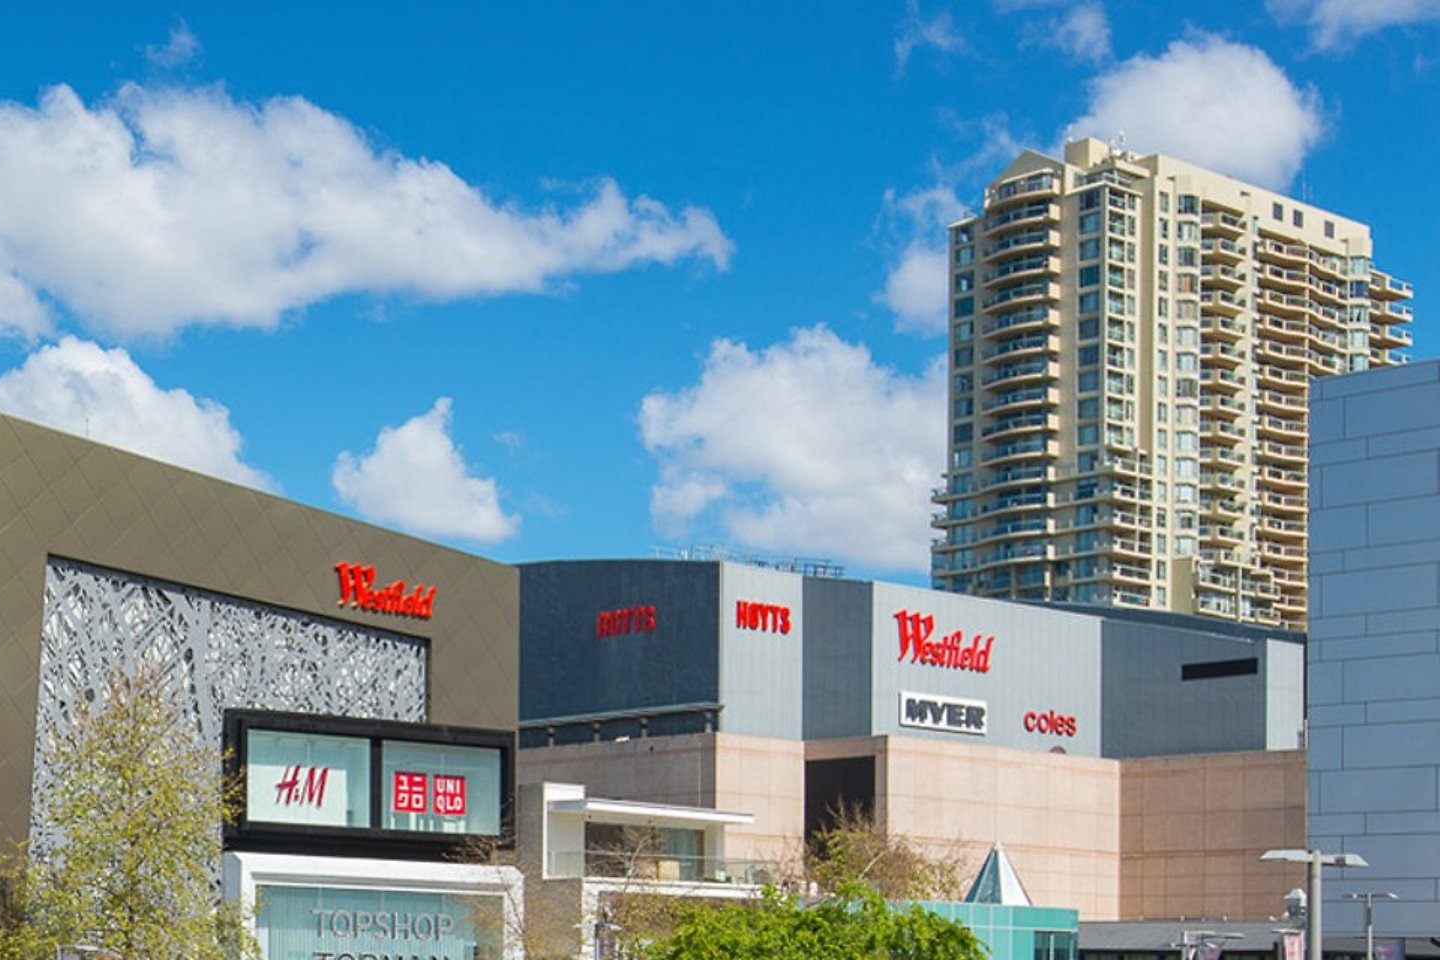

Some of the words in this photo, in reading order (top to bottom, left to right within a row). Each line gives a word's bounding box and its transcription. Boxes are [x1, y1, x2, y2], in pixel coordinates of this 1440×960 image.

[335, 561, 437, 619] Westfield
[736, 600, 791, 635] HOYTS
[893, 609, 994, 674] Westfield
[905, 698, 986, 730] MYER
[1024, 709, 1076, 737] coles
[275, 763, 329, 808] H&M
[312, 908, 455, 941] TOPSHOP
